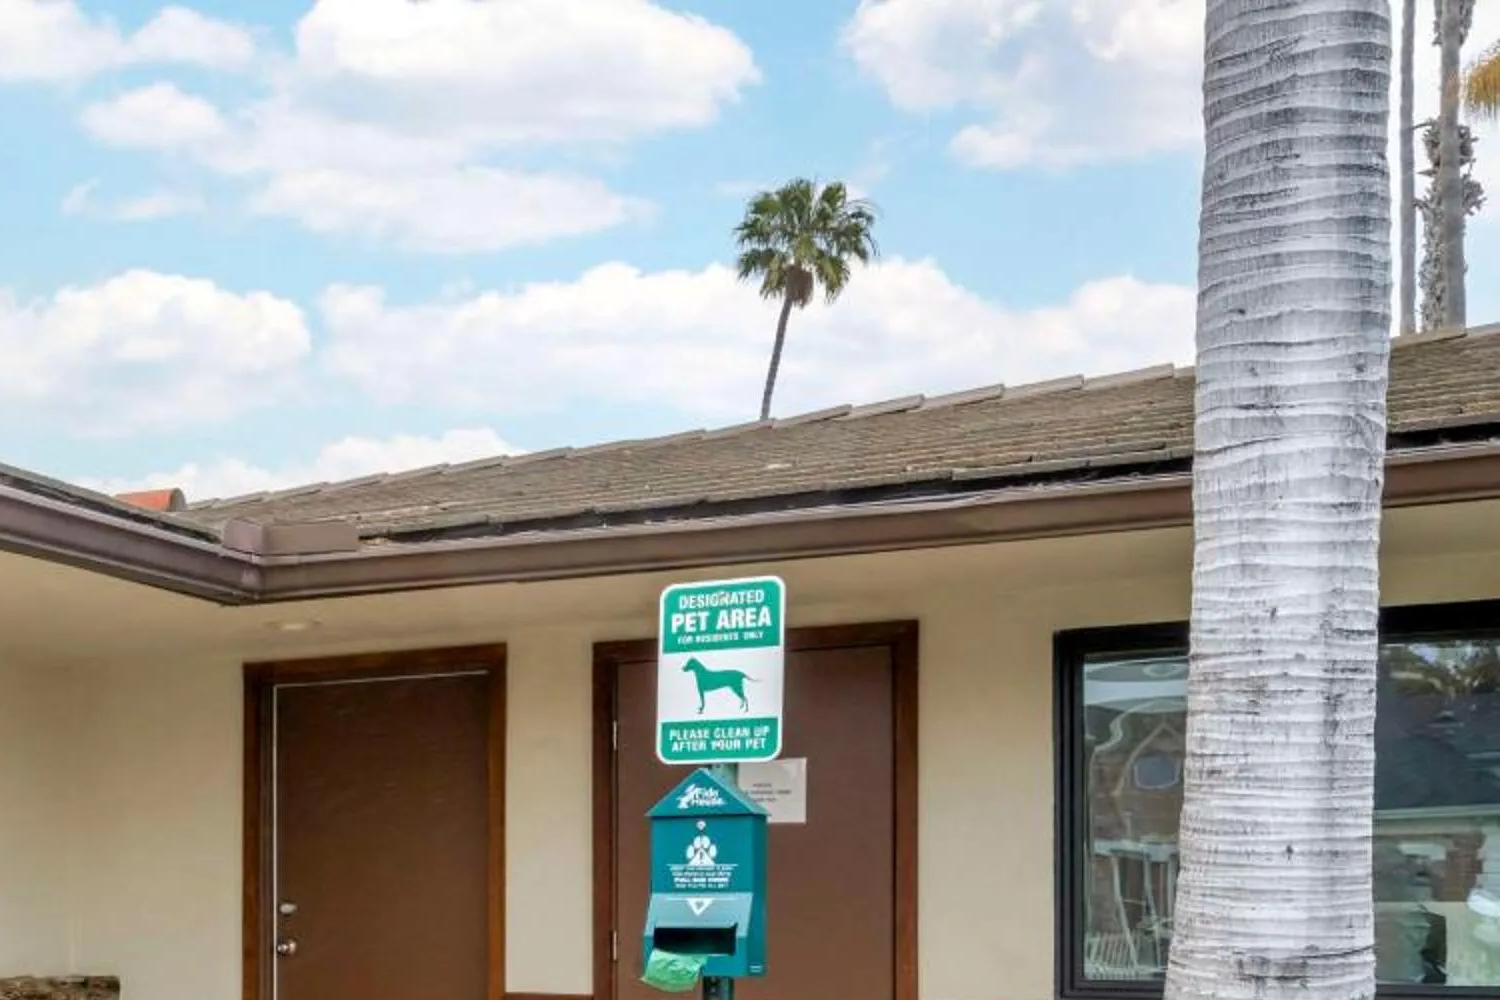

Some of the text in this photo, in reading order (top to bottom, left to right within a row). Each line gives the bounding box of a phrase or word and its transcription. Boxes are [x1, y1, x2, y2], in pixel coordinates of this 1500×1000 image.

[679, 589, 765, 610] DESIGNATED
[671, 605, 772, 634] PET AREA
[669, 725, 770, 741] PLEASE CLEAN UP
[671, 738, 767, 753] AFTER YOUR PET
